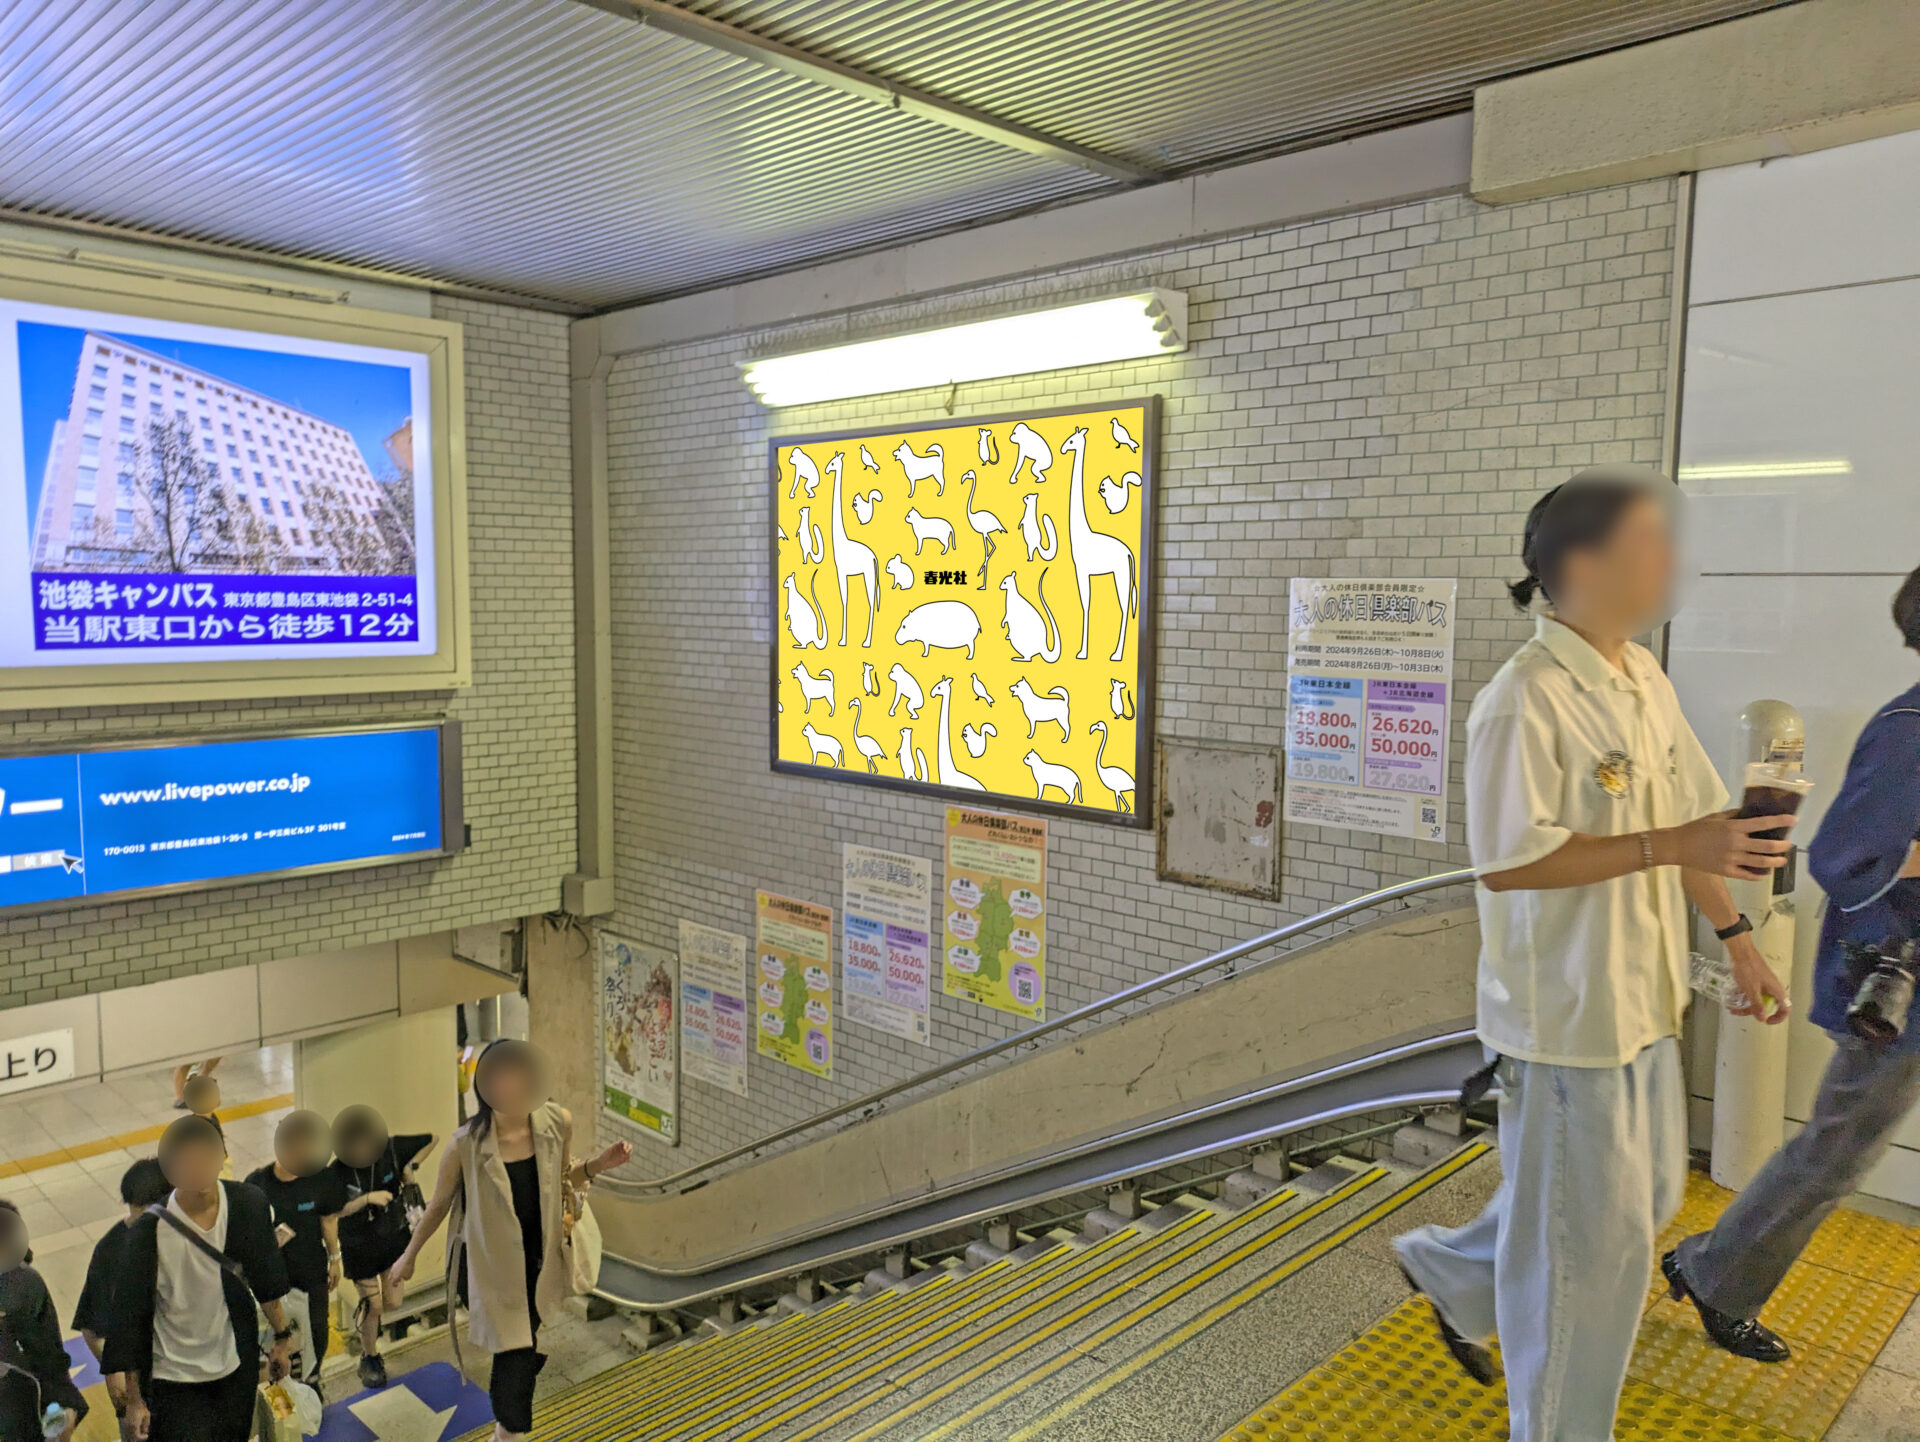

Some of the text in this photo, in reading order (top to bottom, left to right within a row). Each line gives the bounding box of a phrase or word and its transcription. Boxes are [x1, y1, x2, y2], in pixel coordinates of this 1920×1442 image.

[924, 571, 967, 585] 春光社
[39, 580, 217, 610] 池袋キャンパス
[1294, 593, 1448, 628] 大人の休日倶楽部パス
[44, 613, 414, 643] 当駅東口から徒歩12分
[100, 773, 311, 807] www.livepower.co.jp
[104, 844, 145, 856] 170-0013
